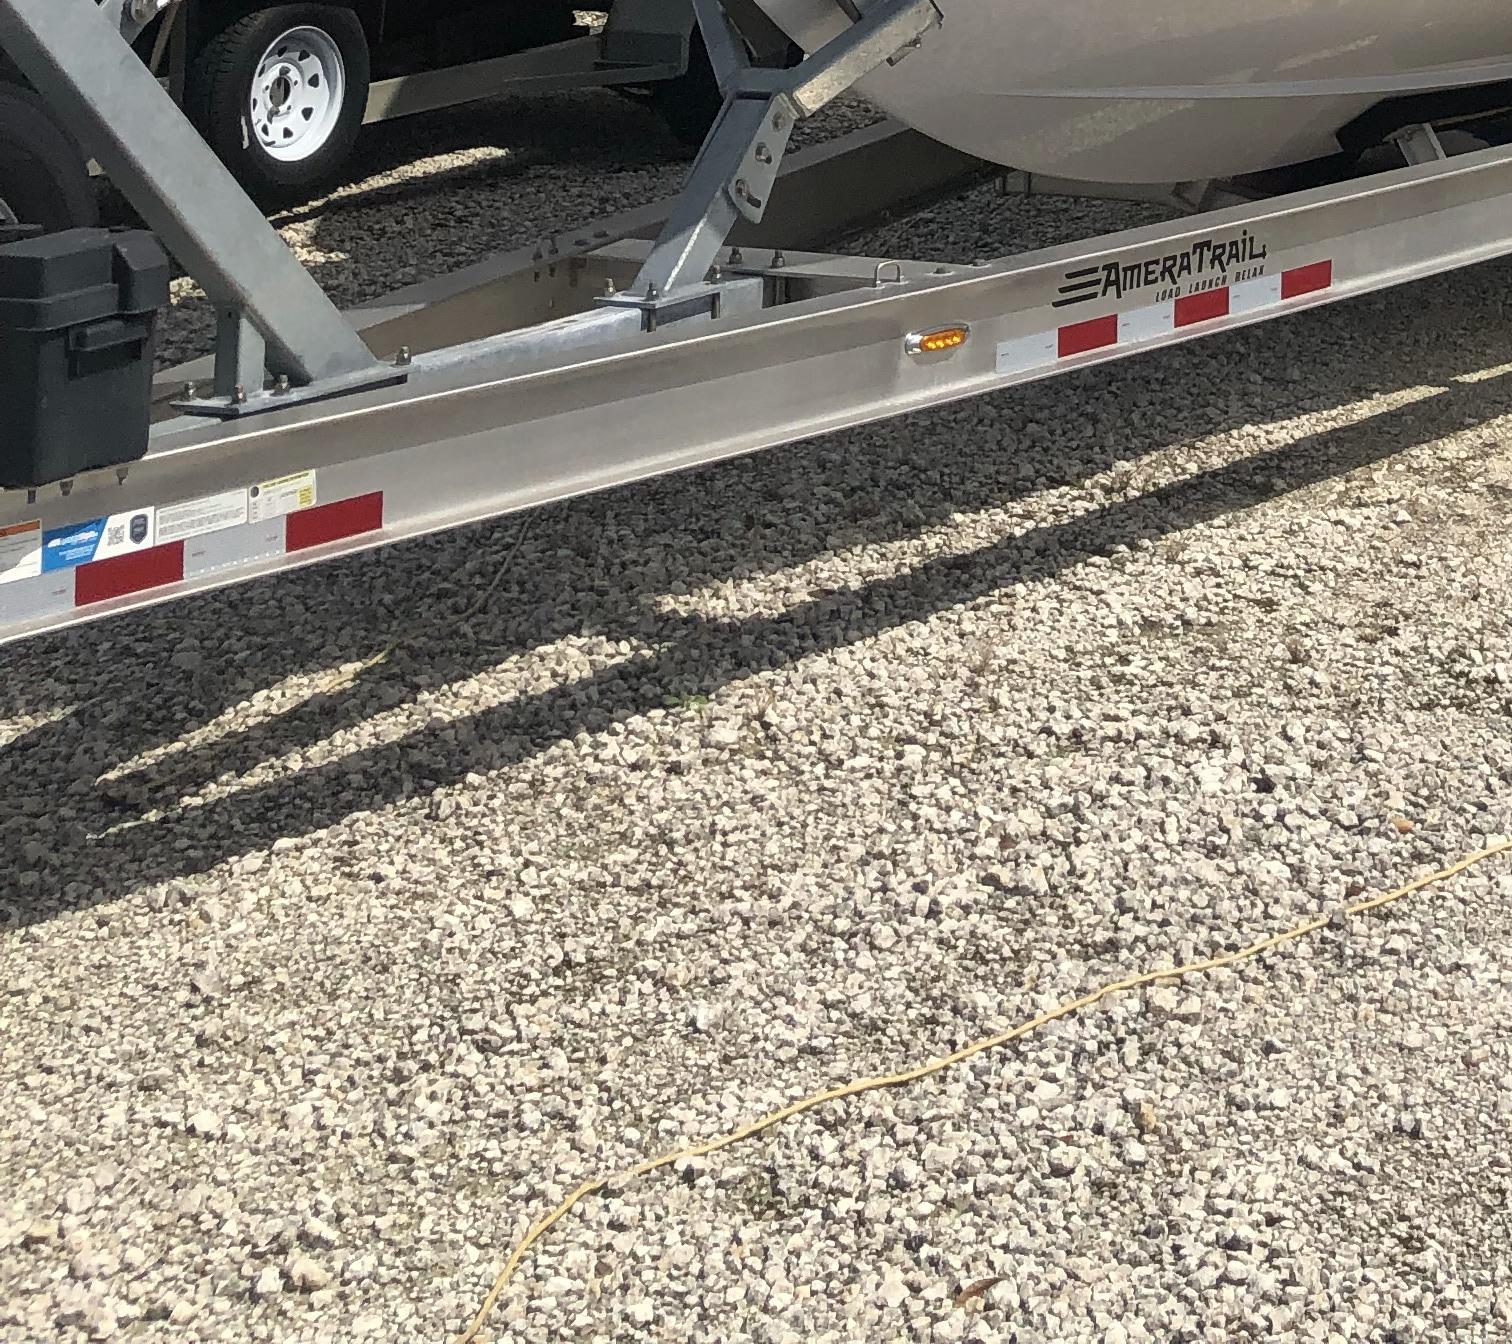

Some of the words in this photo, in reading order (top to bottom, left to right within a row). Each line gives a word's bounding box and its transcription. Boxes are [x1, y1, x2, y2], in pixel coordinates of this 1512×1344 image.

[1155, 286, 1181, 303] LOAD
[1188, 274, 1228, 295] LAUNCH
[1234, 264, 1265, 283] RELAX
